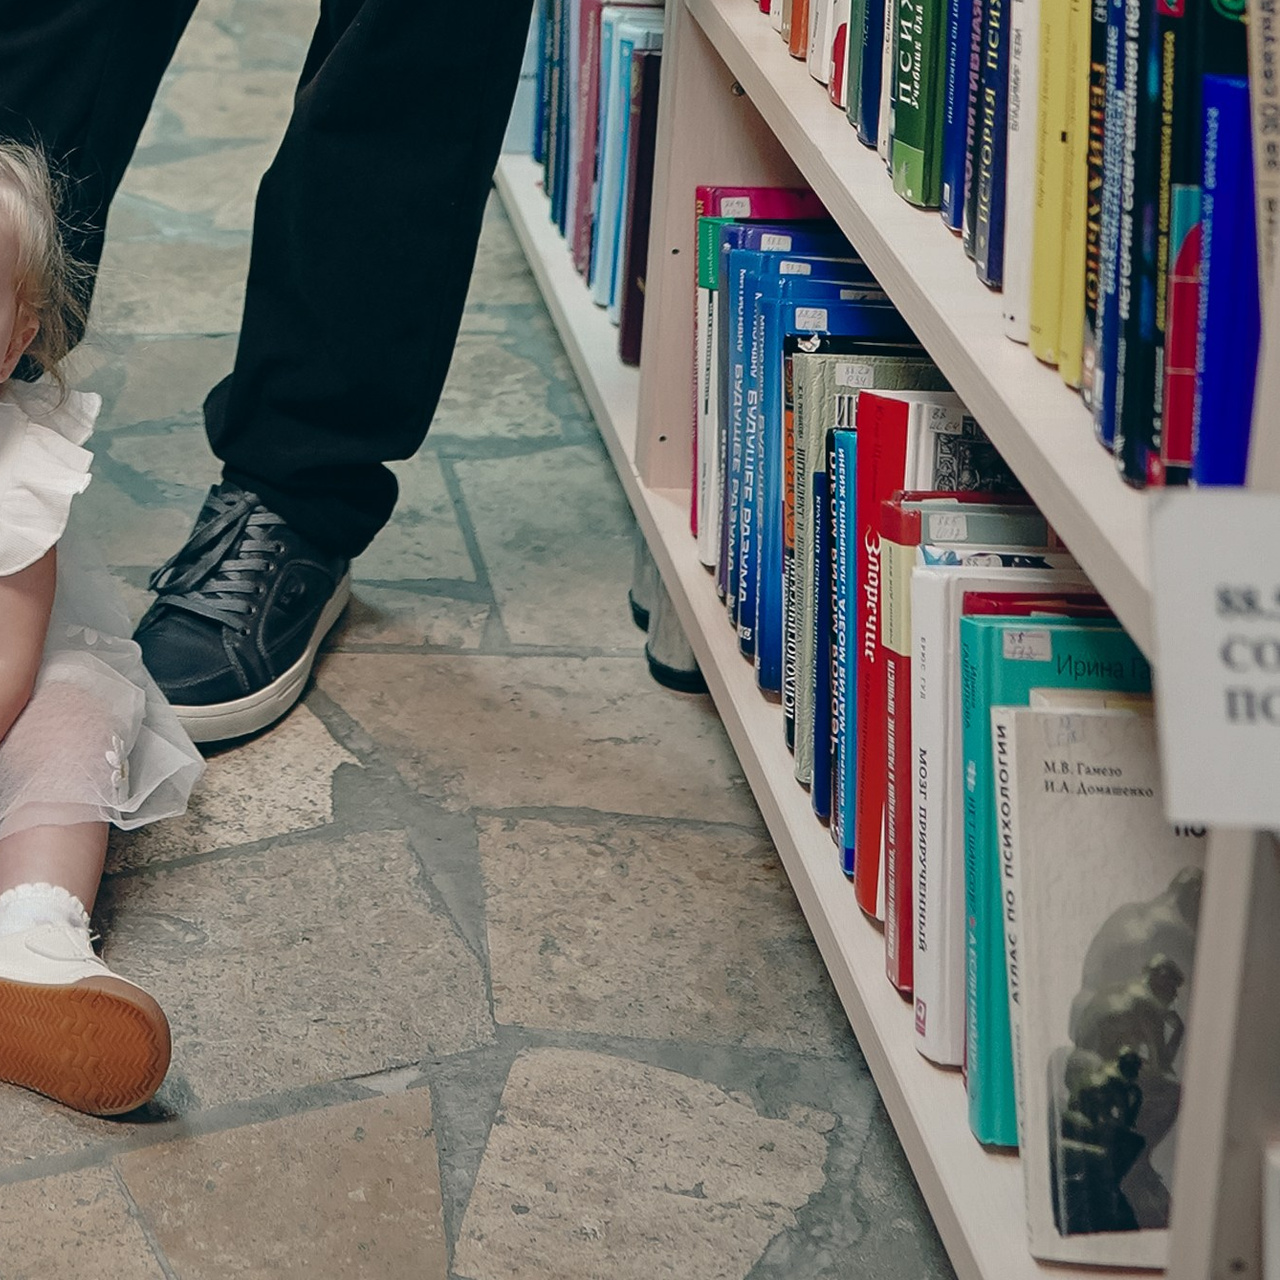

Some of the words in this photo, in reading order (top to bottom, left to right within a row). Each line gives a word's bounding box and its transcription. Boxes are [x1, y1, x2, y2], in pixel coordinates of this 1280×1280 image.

[913, 5, 924, 34] для
[951, 21, 958, 38] ПО
[911, 42, 922, 109] Учебник
[947, 41, 957, 124] ПСИХОЛОГИИ
[977, 86, 997, 223] ИСТОРИЯ
[731, 364, 743, 474] БУДУЩЕЕ
[743, 389, 758, 503] БУДУЩЕЕ
[727, 478, 740, 572] РАЗУМА
[738, 506, 753, 602] РАЗУМА
[839, 501, 847, 586] ЛАБИРИНТЫ
[864, 524, 882, 663] Злоречие
[783, 553, 798, 719] ПСИХОЛОГИЧЕСКИЙ
[837, 597, 847, 663] МОЗГА
[837, 665, 848, 731] МАГИЯ
[886, 659, 896, 712] ЛИЧНОСТИ
[1056, 655, 1124, 681] Ирина
[886, 715, 896, 773] РАЗВИТИЕ
[919, 747, 928, 801] МОЗГ
[1043, 761, 1073, 776] М.В.
[1077, 761, 1123, 779] Гамезо
[886, 784, 896, 844] КОРРЕКЦИЯ
[996, 724, 1014, 877] ПСИХОЛОГИИ
[1044, 781, 1073, 795] И.А.
[1076, 783, 1154, 799] Домашенко
[918, 804, 929, 952] ПРИРУЧЕННЫЙ
[1006, 890, 1015, 921] ПО
[1007, 934, 1020, 1004] АТЛАС
